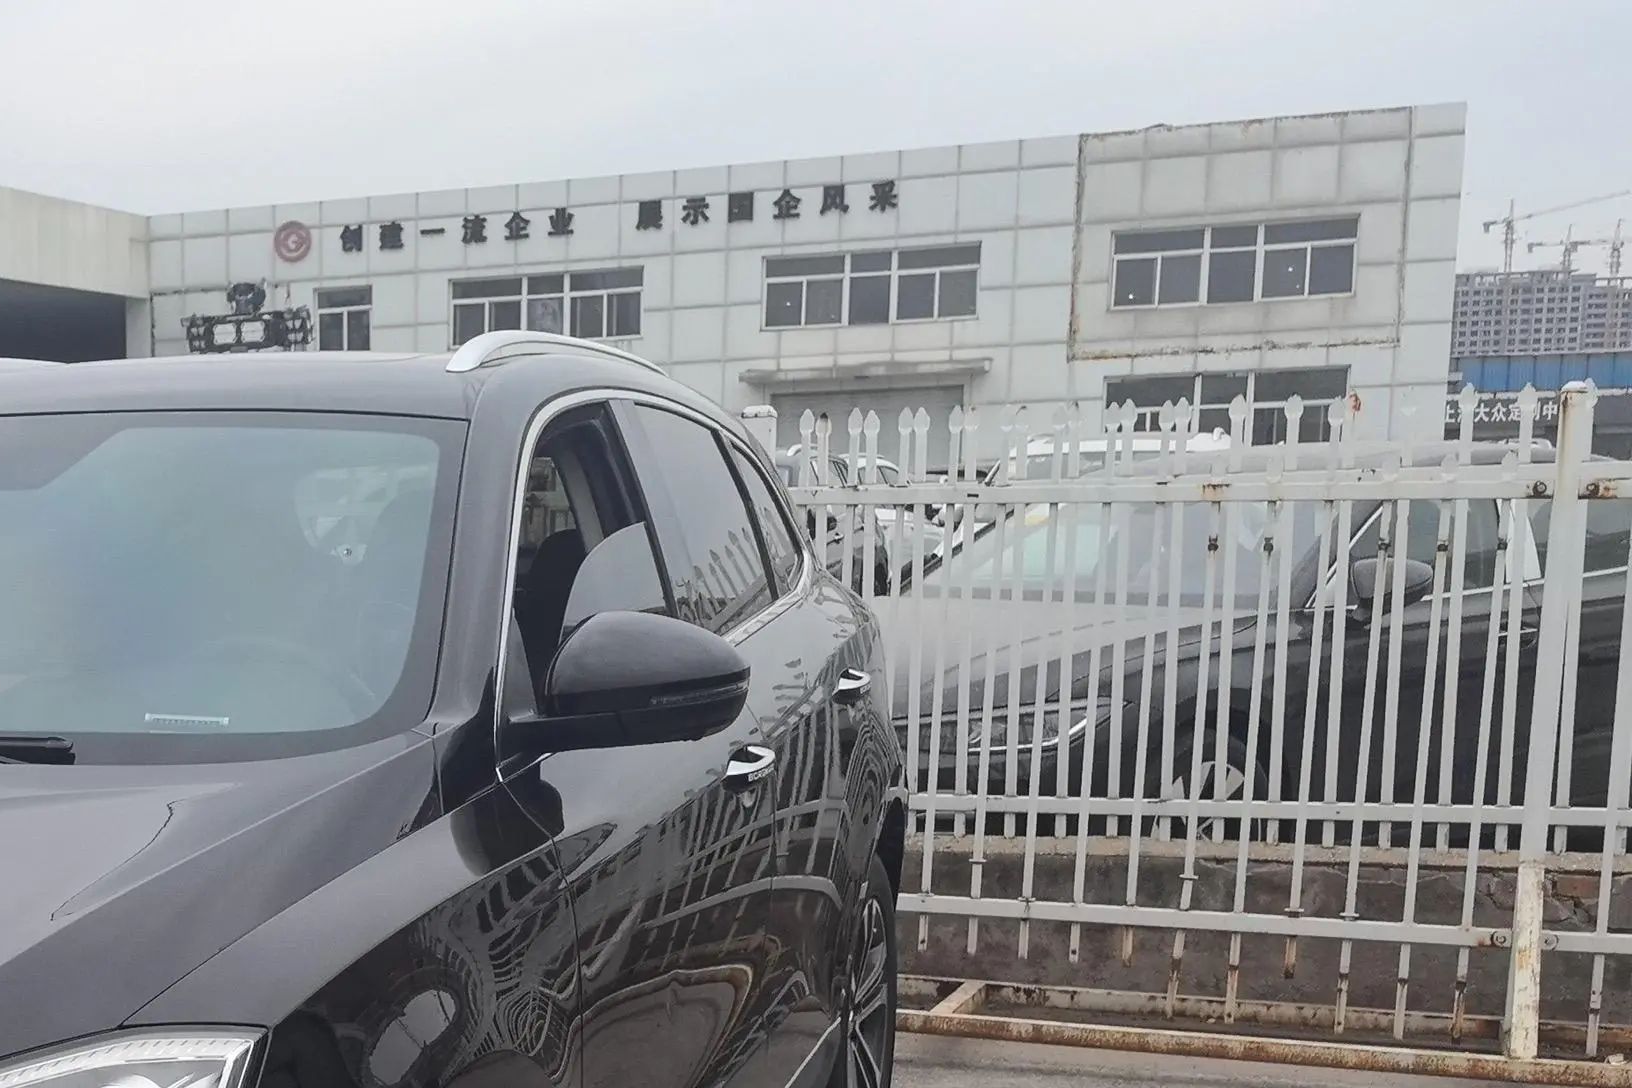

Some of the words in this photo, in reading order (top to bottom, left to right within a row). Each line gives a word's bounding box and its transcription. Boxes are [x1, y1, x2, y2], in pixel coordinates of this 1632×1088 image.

[340, 207, 574, 252] 创建一流企业
